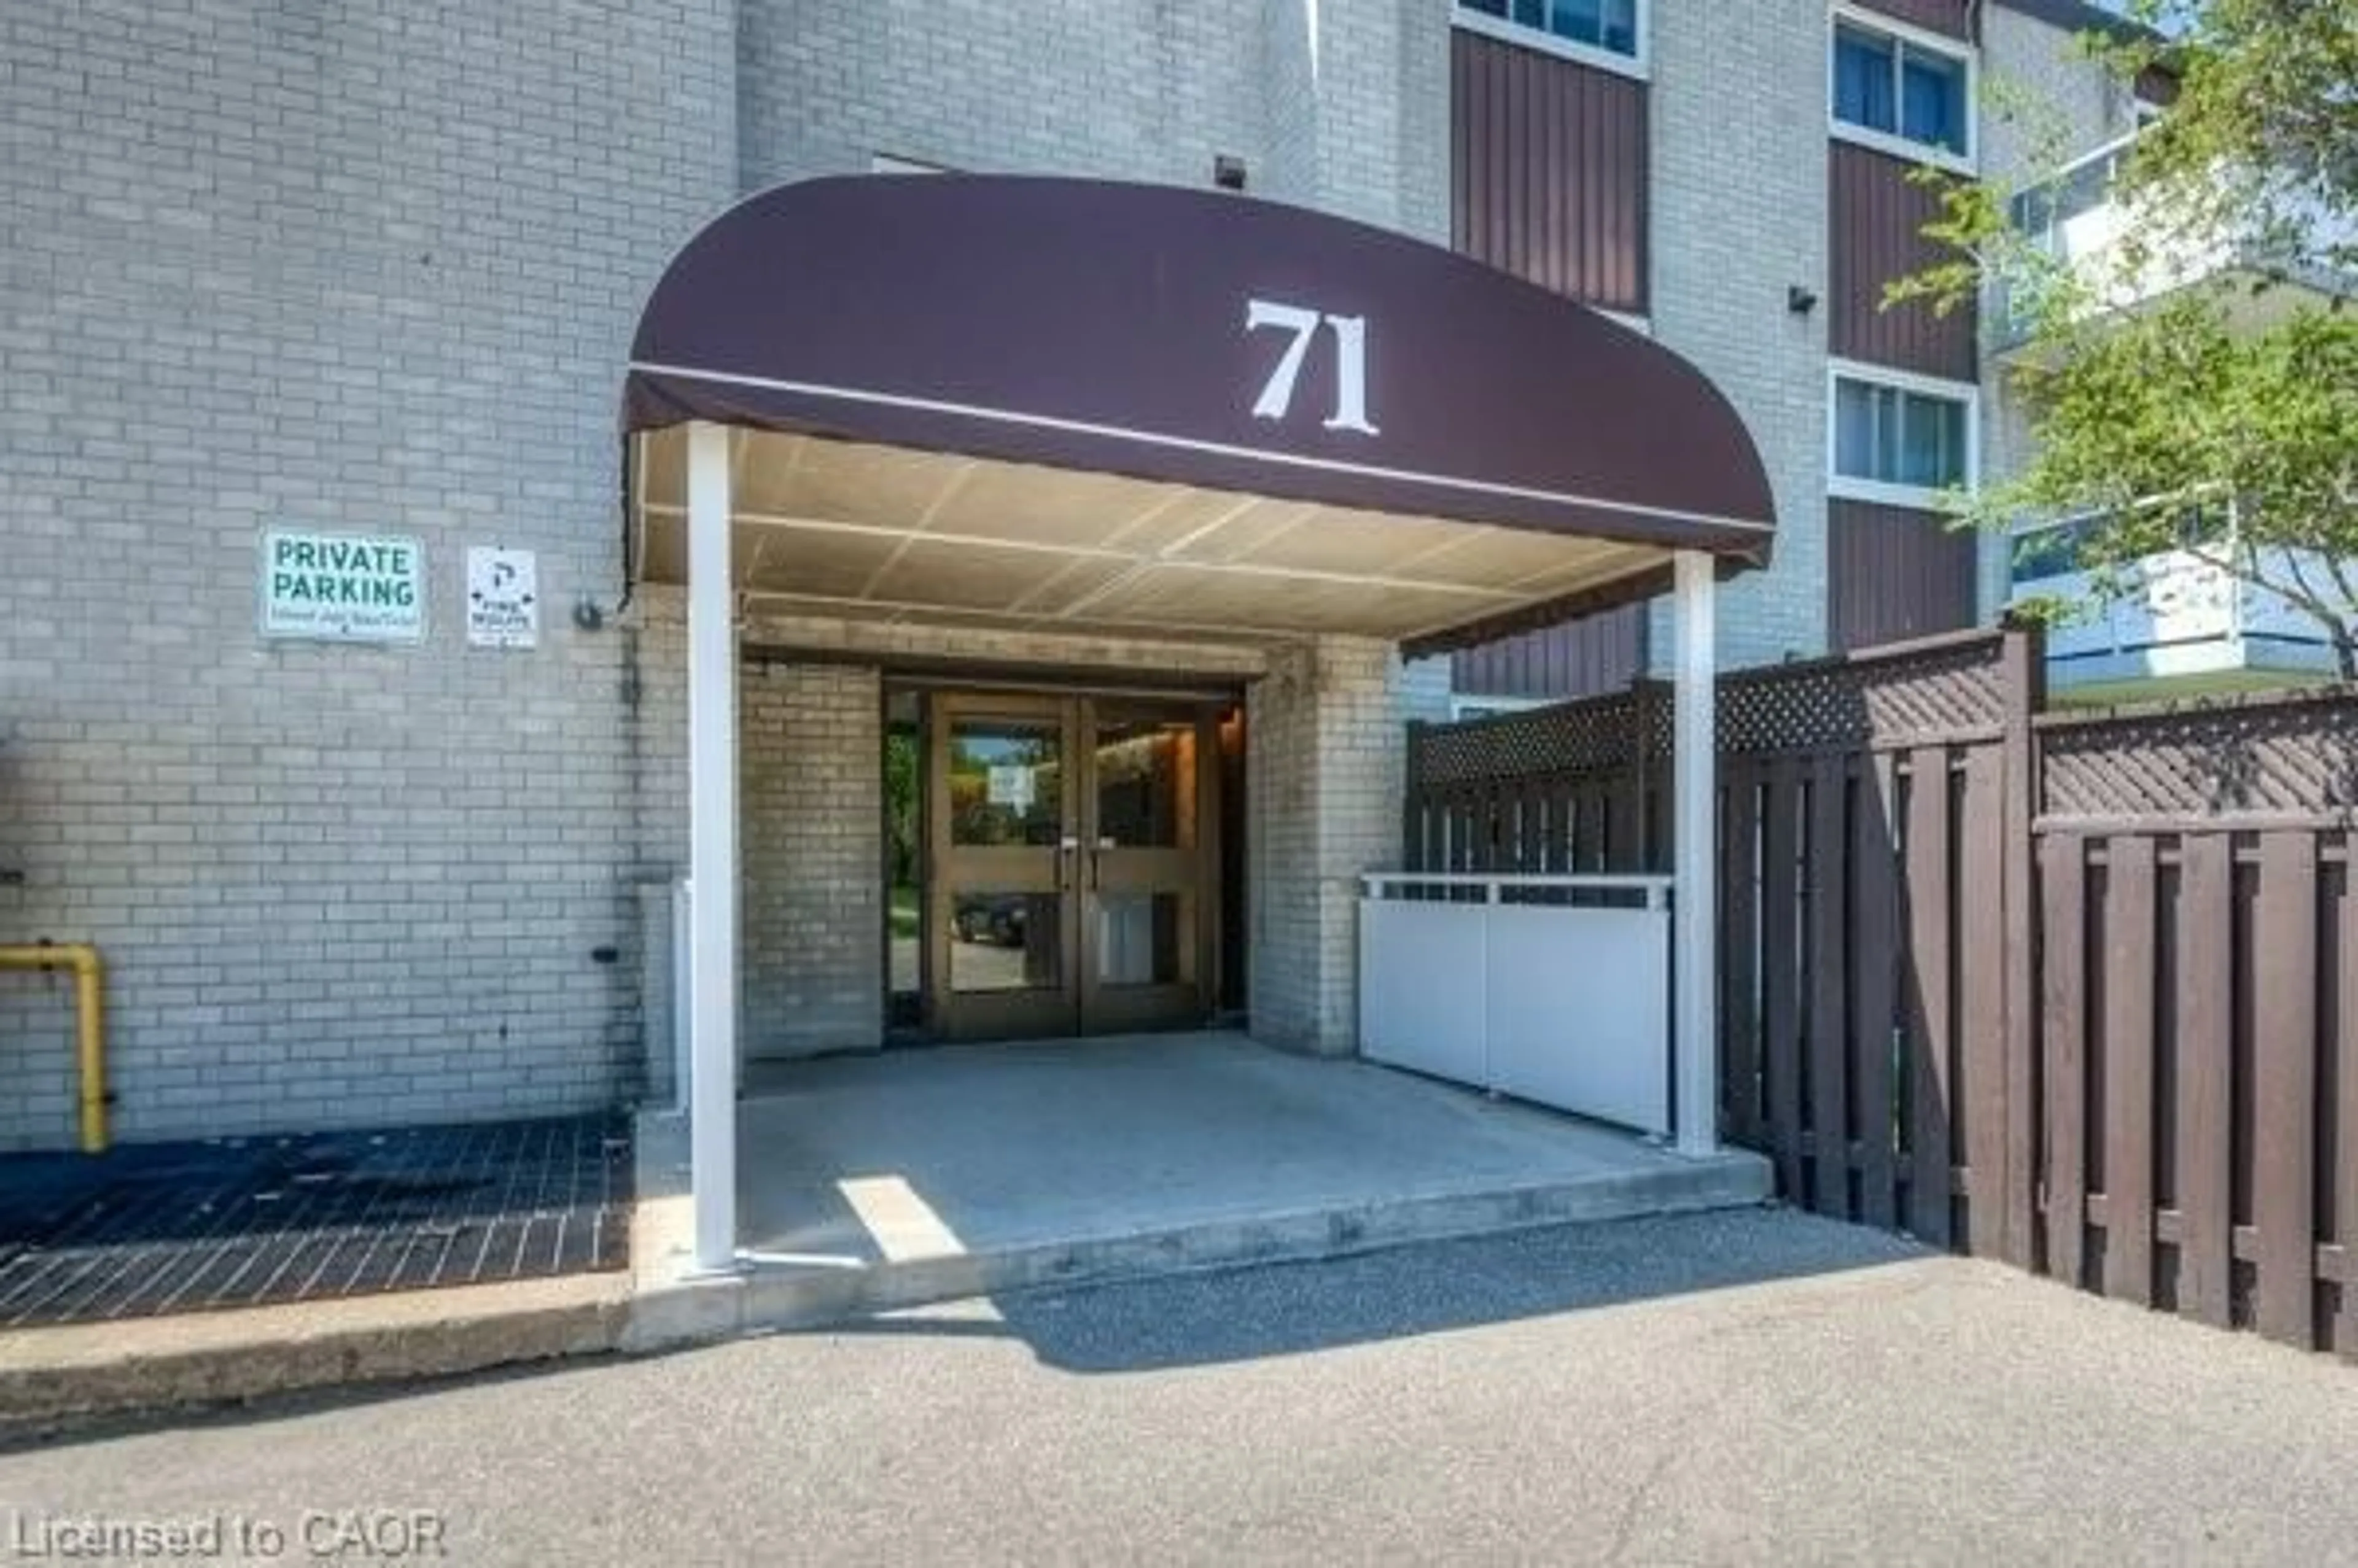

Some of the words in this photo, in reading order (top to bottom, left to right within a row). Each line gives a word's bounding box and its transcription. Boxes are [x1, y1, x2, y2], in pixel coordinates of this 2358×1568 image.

[1246, 299, 1380, 435] 71
[275, 538, 410, 575] PRIVATE
[274, 572, 414, 606] PARKING
